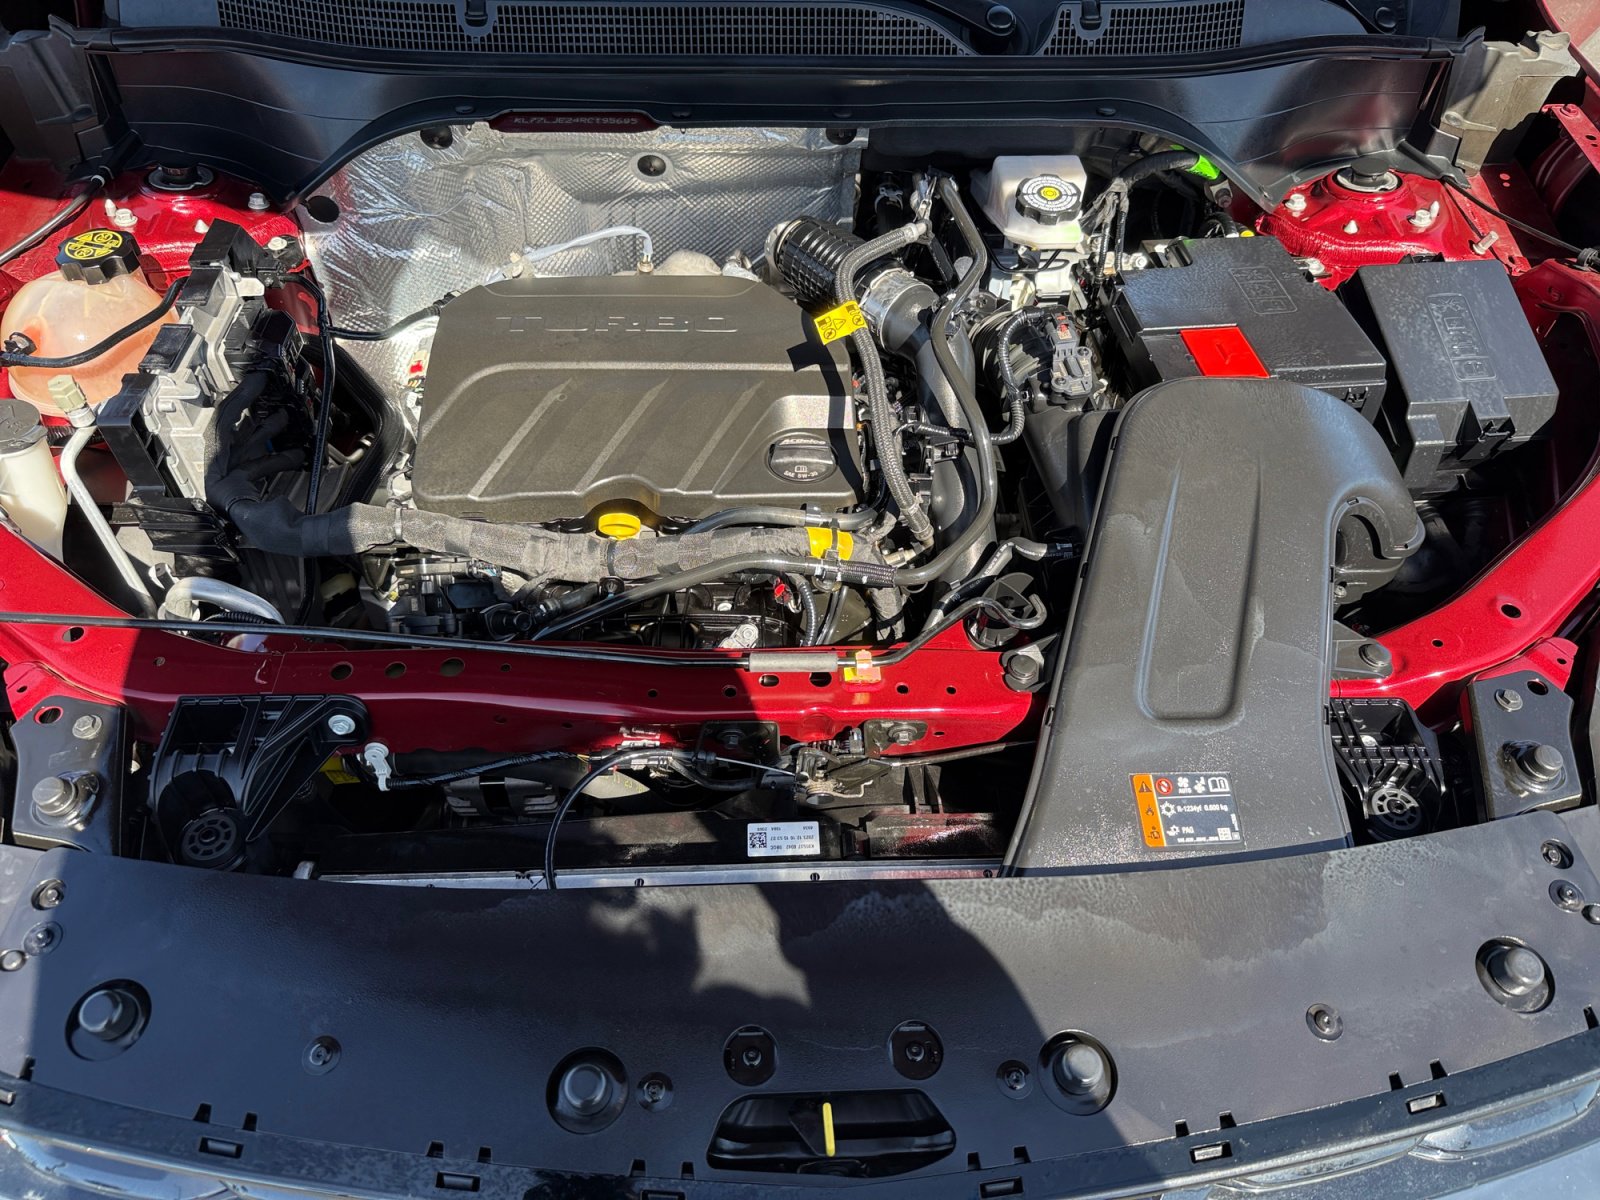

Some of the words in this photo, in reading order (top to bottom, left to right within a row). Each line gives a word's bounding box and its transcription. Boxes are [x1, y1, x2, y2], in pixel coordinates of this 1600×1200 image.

[495, 316, 738, 333] TURBO
[778, 437, 827, 446] ACDelco
[783, 470, 796, 478] SAE
[1219, 803, 1229, 812] kg
